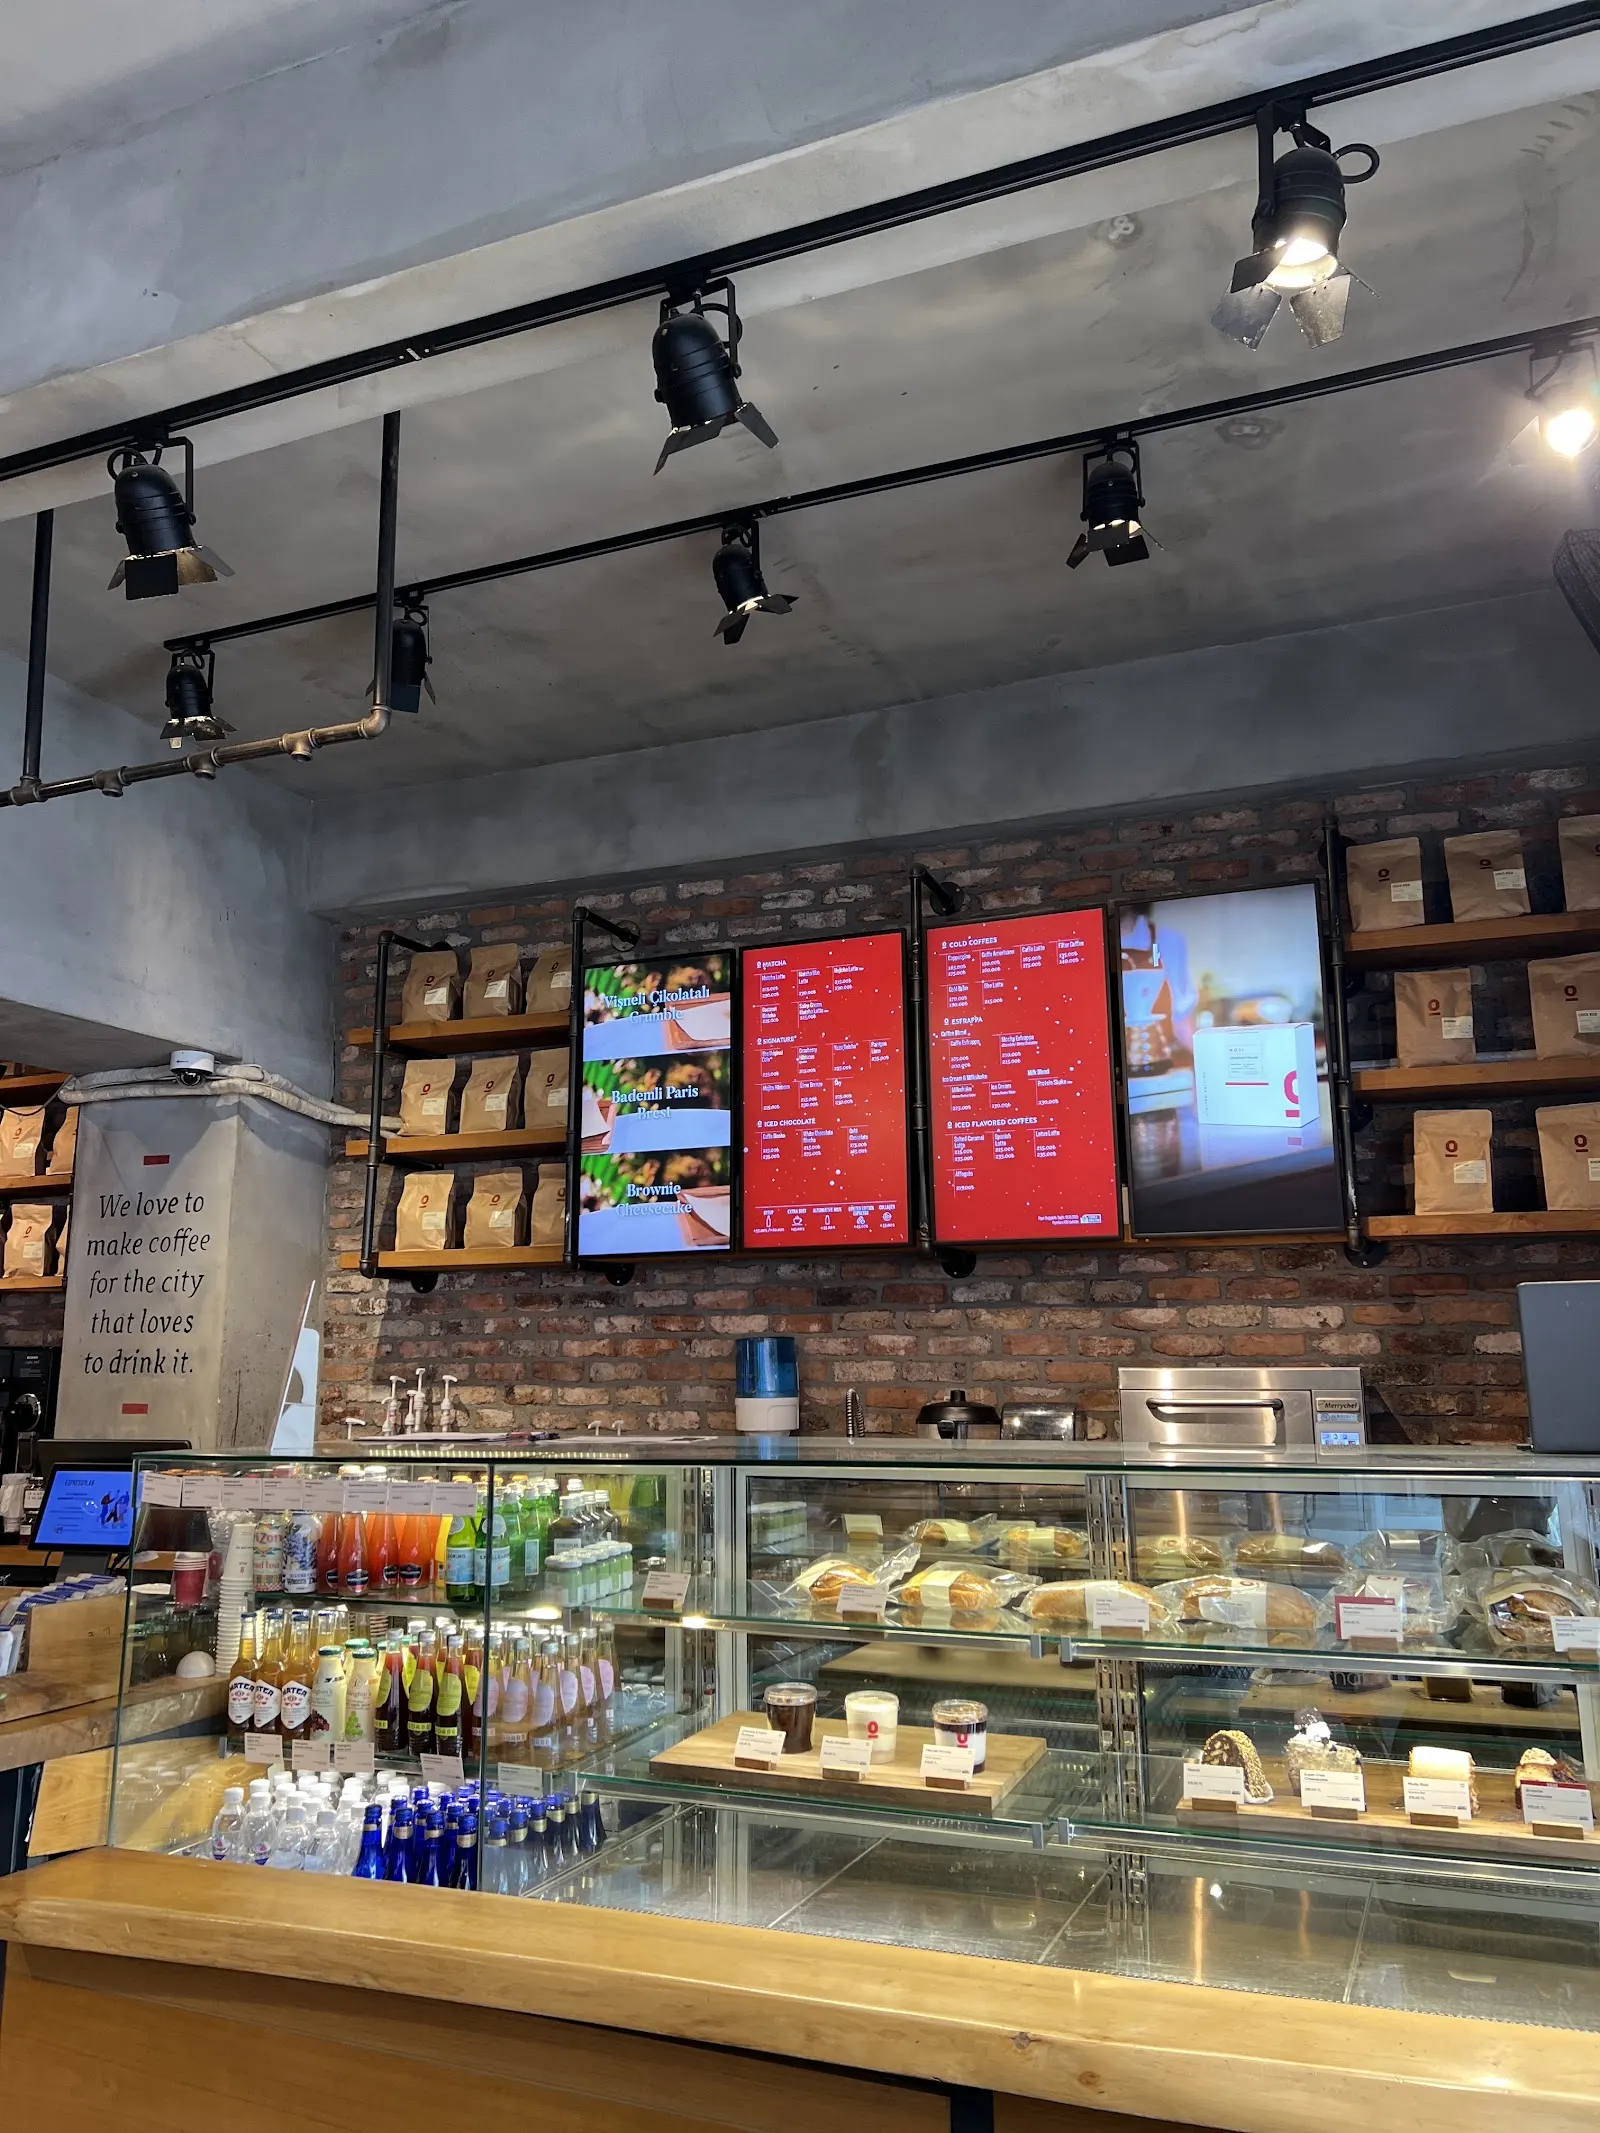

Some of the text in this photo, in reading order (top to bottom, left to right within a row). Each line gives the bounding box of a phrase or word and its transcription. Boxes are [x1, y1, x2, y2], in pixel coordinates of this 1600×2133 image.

[969, 937, 997, 945] COFFEES
[604, 985, 711, 1010] Vişneli Çikolatalı
[629, 1009, 684, 1024] Crumble
[952, 1016, 983, 1025] ESFRAPPA
[611, 1085, 699, 1103] Bademli Paris
[637, 1107, 672, 1120] Brest
[779, 1118, 815, 1126] CHOCOLATE
[972, 1119, 1006, 1127] FLAVORED
[626, 1183, 682, 1198] Brownie
[100, 1192, 204, 1219] We love to
[615, 1203, 693, 1217] Cheesecake
[87, 1227, 210, 1257] make coffee
[89, 1269, 204, 1298] for the city
[91, 1308, 194, 1334] that loves
[84, 1348, 193, 1374] to drink it.
[1325, 1400, 1358, 1410] Merrychef
